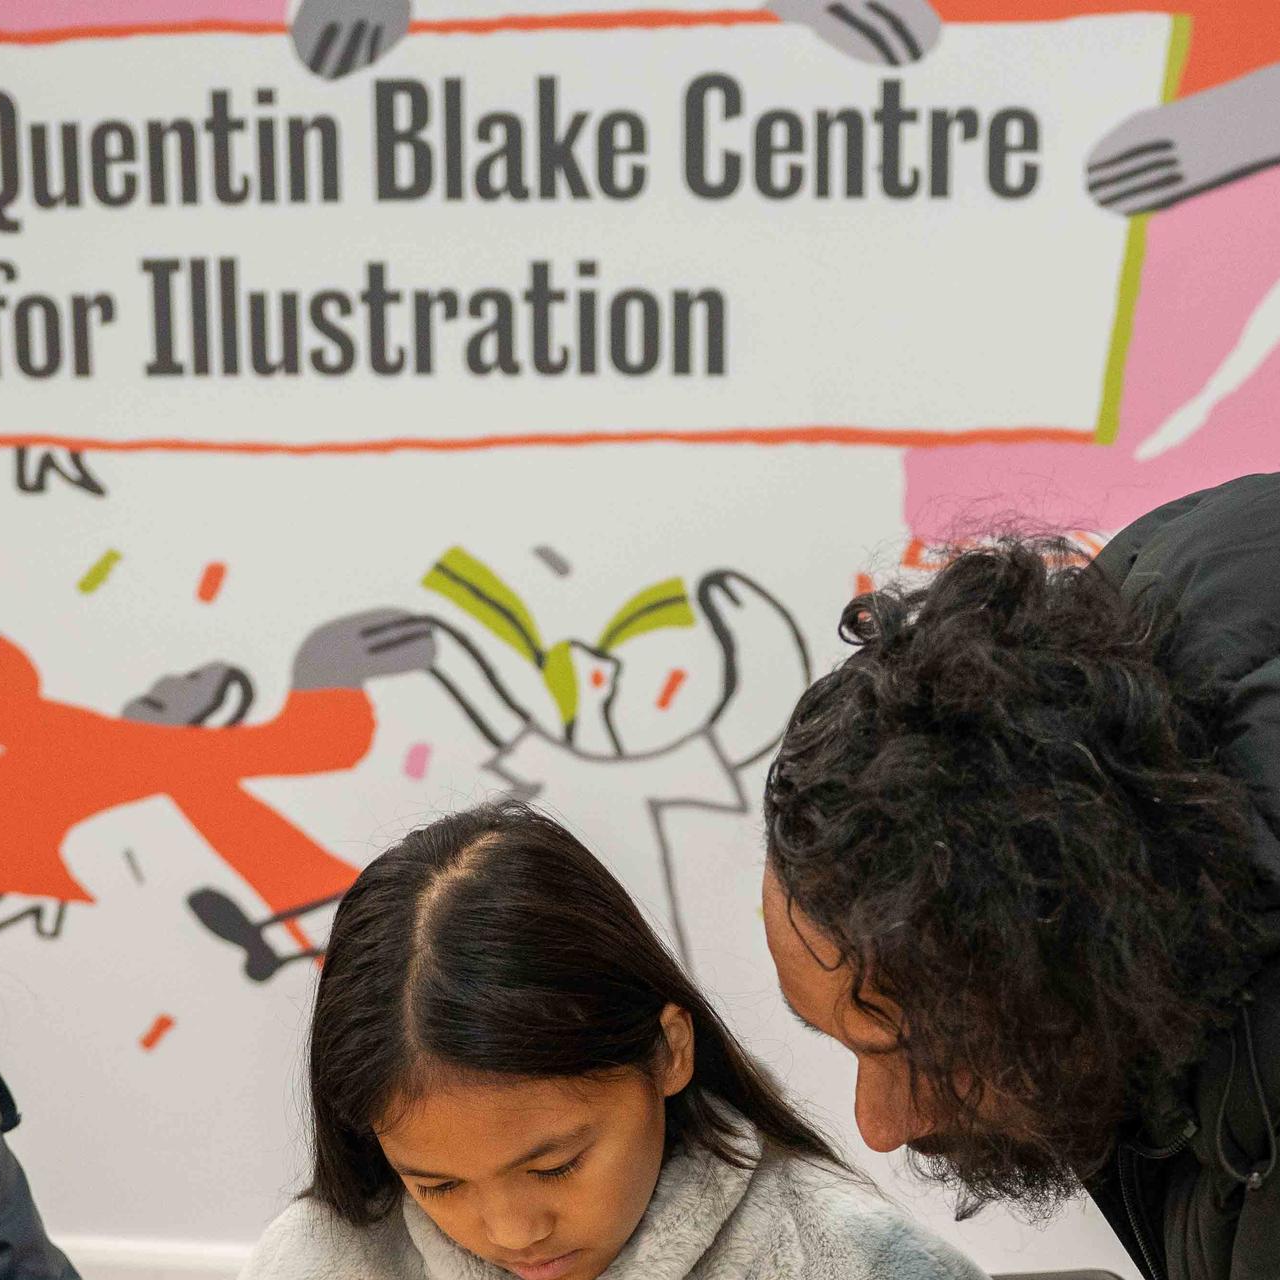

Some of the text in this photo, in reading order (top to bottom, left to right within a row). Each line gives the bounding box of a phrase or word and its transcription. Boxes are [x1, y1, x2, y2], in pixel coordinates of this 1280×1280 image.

[373, 76, 648, 201] Blake
[683, 72, 1040, 200] Centre
[140, 257, 726, 377] Illustration
